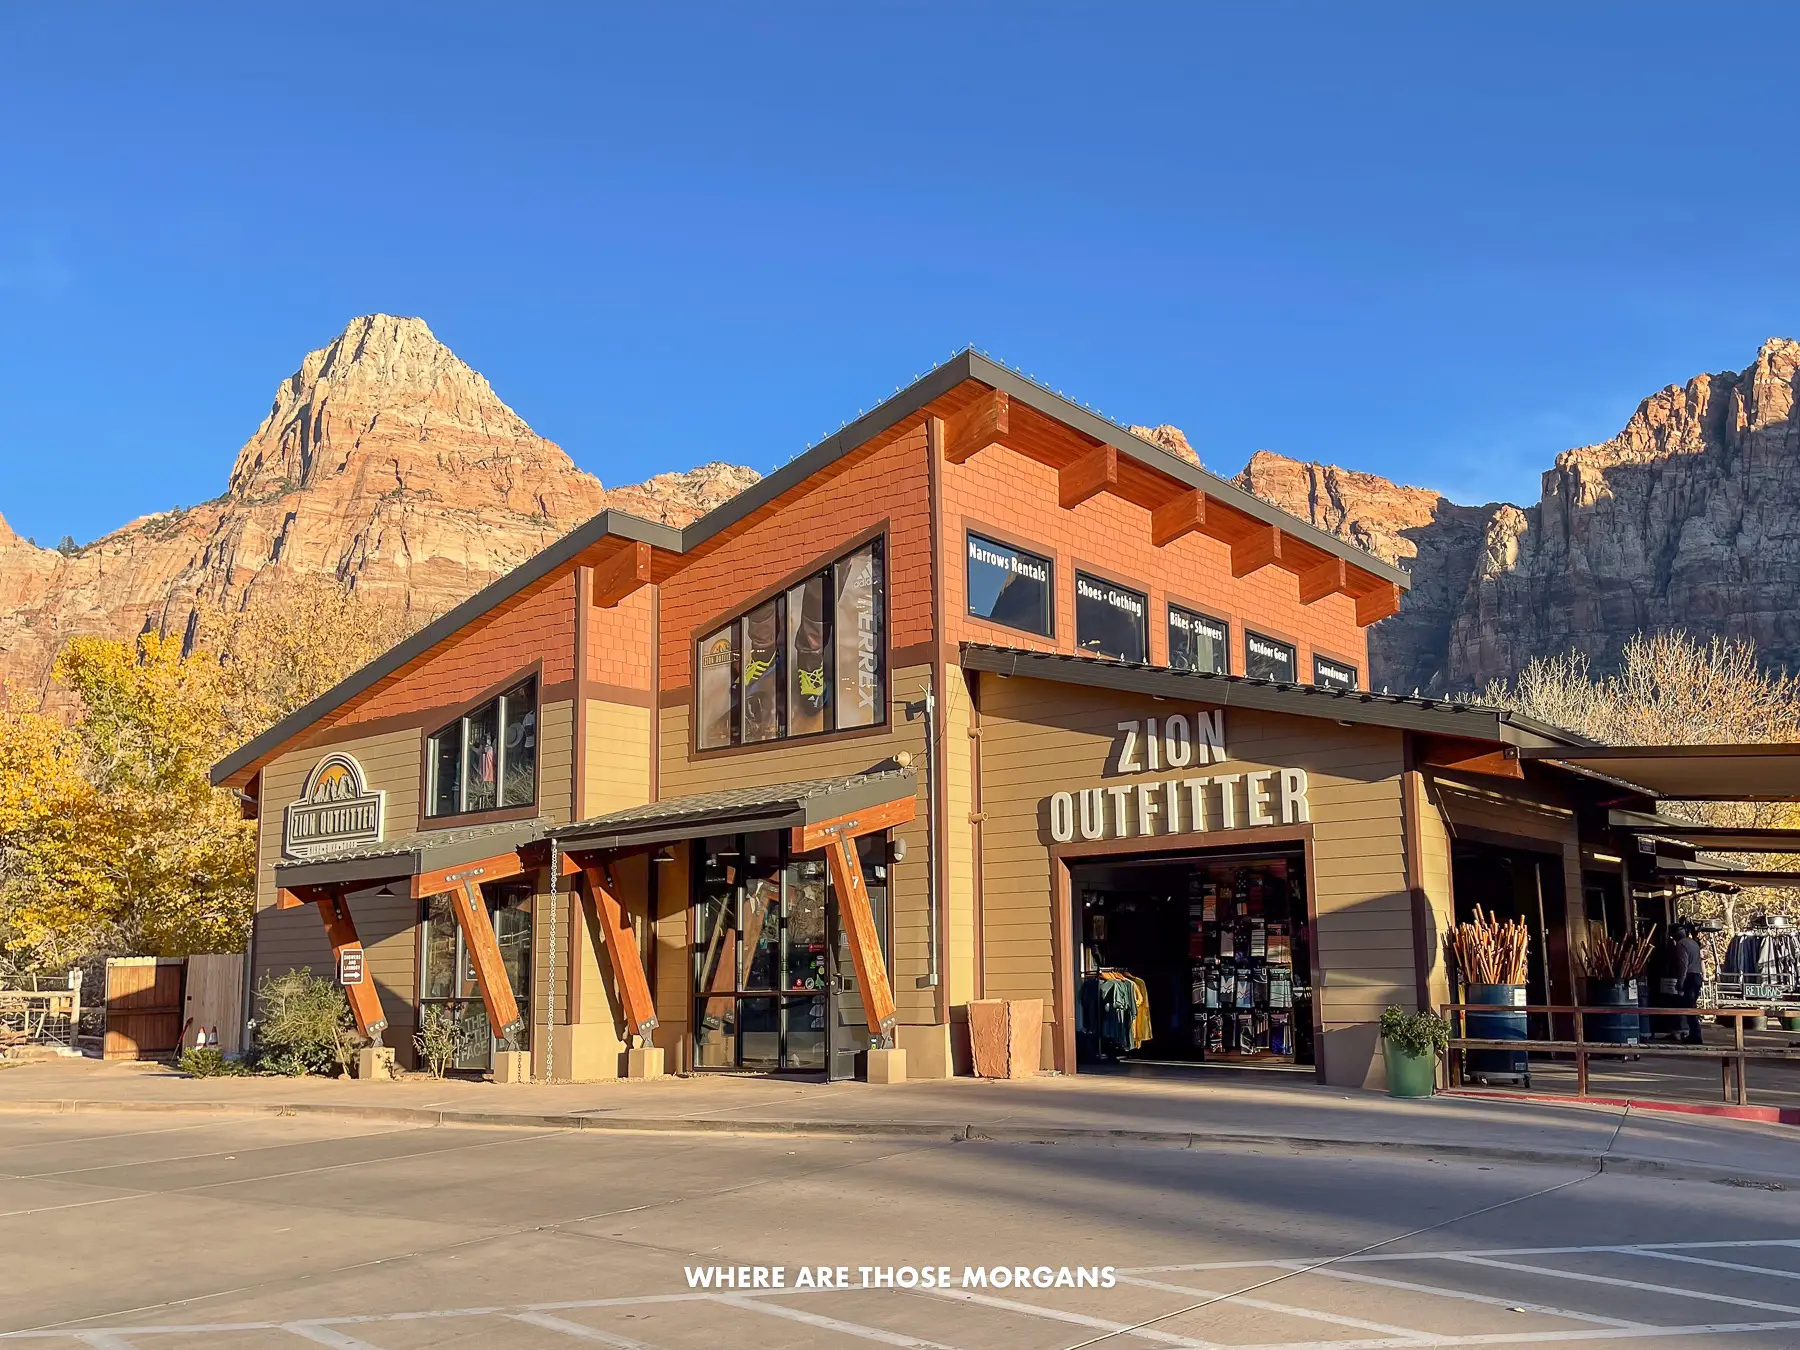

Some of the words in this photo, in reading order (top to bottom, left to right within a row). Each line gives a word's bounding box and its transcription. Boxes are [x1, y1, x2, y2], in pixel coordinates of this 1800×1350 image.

[969, 542, 1009, 570] Narrows
[1011, 556, 1046, 582] Rentals
[1078, 580, 1102, 601] Shoes
[1108, 590, 1141, 617] Clothing
[1170, 611, 1189, 630] Bikes
[1194, 620, 1222, 641] Showers
[1249, 638, 1273, 658] Outdoor
[1273, 647, 1287, 663] Gear
[1117, 709, 1227, 773] ZION
[293, 812, 316, 837] ZION
[320, 805, 375, 834] OUTFITTER
[1050, 768, 1311, 843] OUTFITTER
[1745, 985, 1782, 997] RETURNS
[465, 1013, 485, 1031] THE
